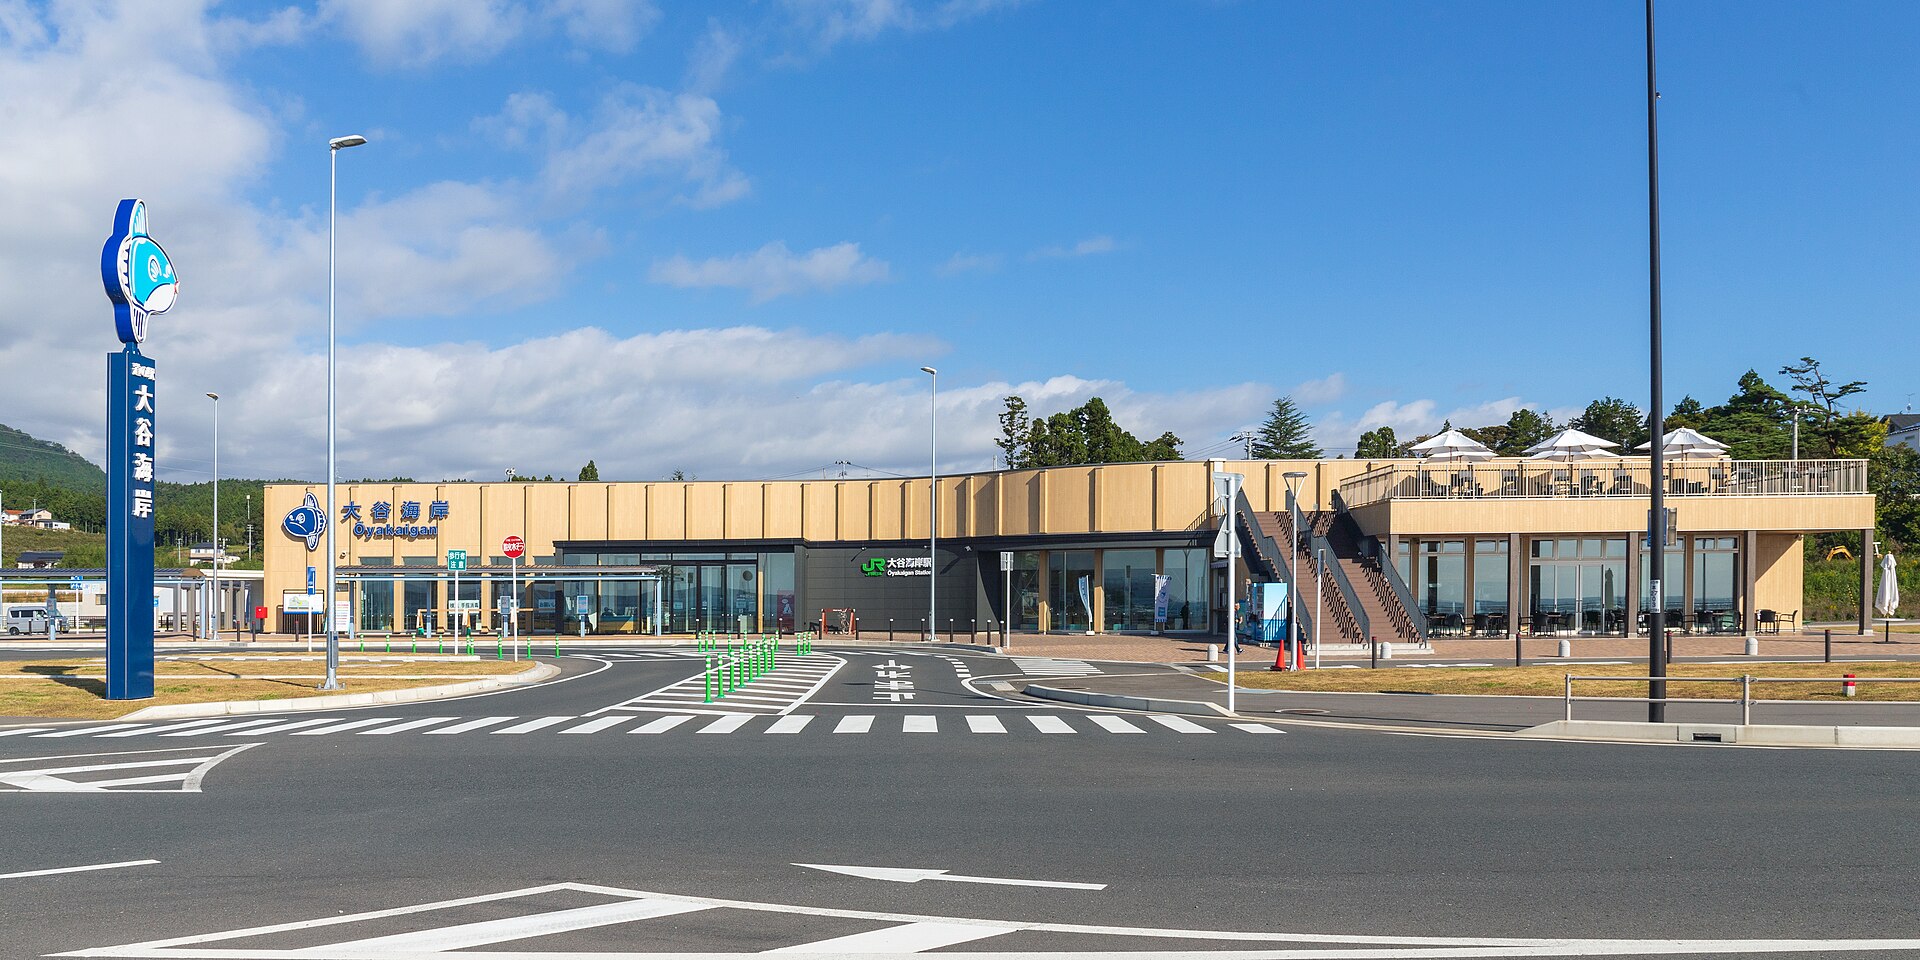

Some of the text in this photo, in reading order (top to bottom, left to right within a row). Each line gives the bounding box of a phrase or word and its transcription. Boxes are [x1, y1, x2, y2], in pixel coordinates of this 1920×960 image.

[132, 384, 154, 519] 大谷海岸
[343, 500, 450, 520] 大谷海岸
[449, 551, 466, 560] 歩行者
[862, 558, 886, 572] JR
[887, 557, 932, 569] 大谷海岸駅
